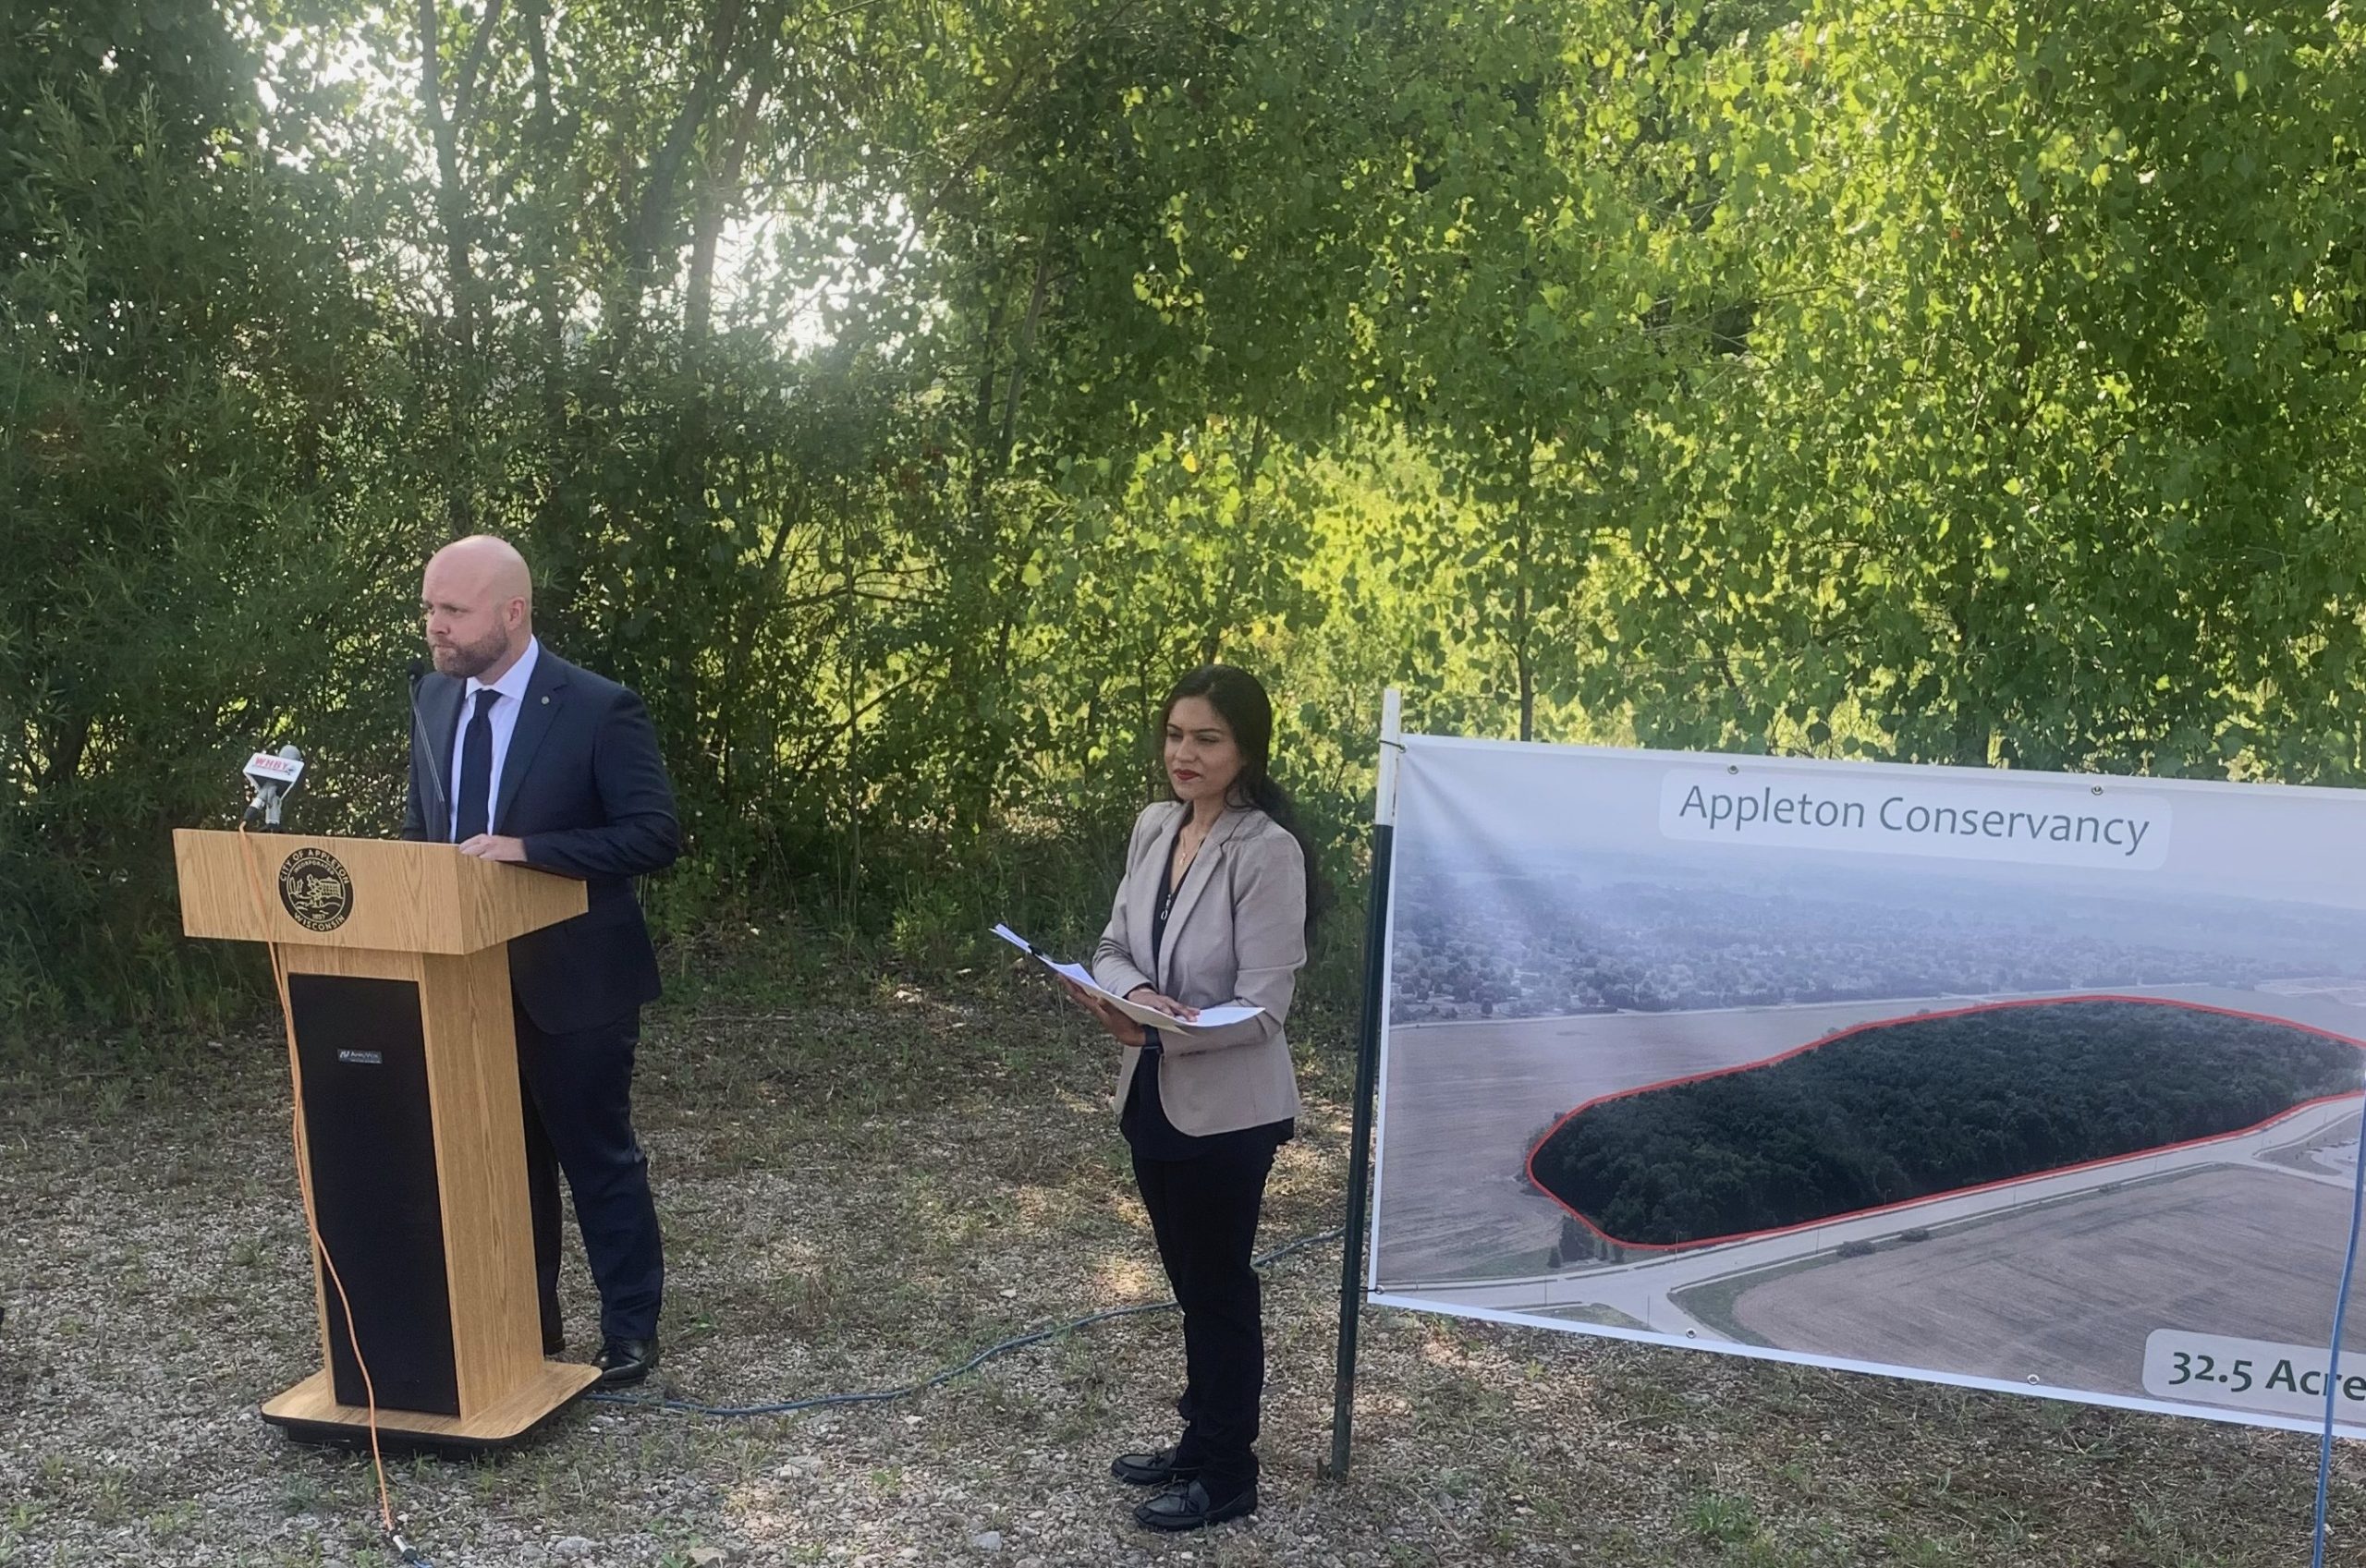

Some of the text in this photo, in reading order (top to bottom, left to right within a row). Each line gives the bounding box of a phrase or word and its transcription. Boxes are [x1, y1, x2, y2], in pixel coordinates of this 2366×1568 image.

[254, 757, 289, 770] WHBY
[1679, 784, 2151, 857] Appleton Conservancy
[280, 849, 350, 884] CITY OF APPLETON
[294, 912, 346, 931] WISCONSIN
[2168, 1351, 2253, 1392] 32.5
